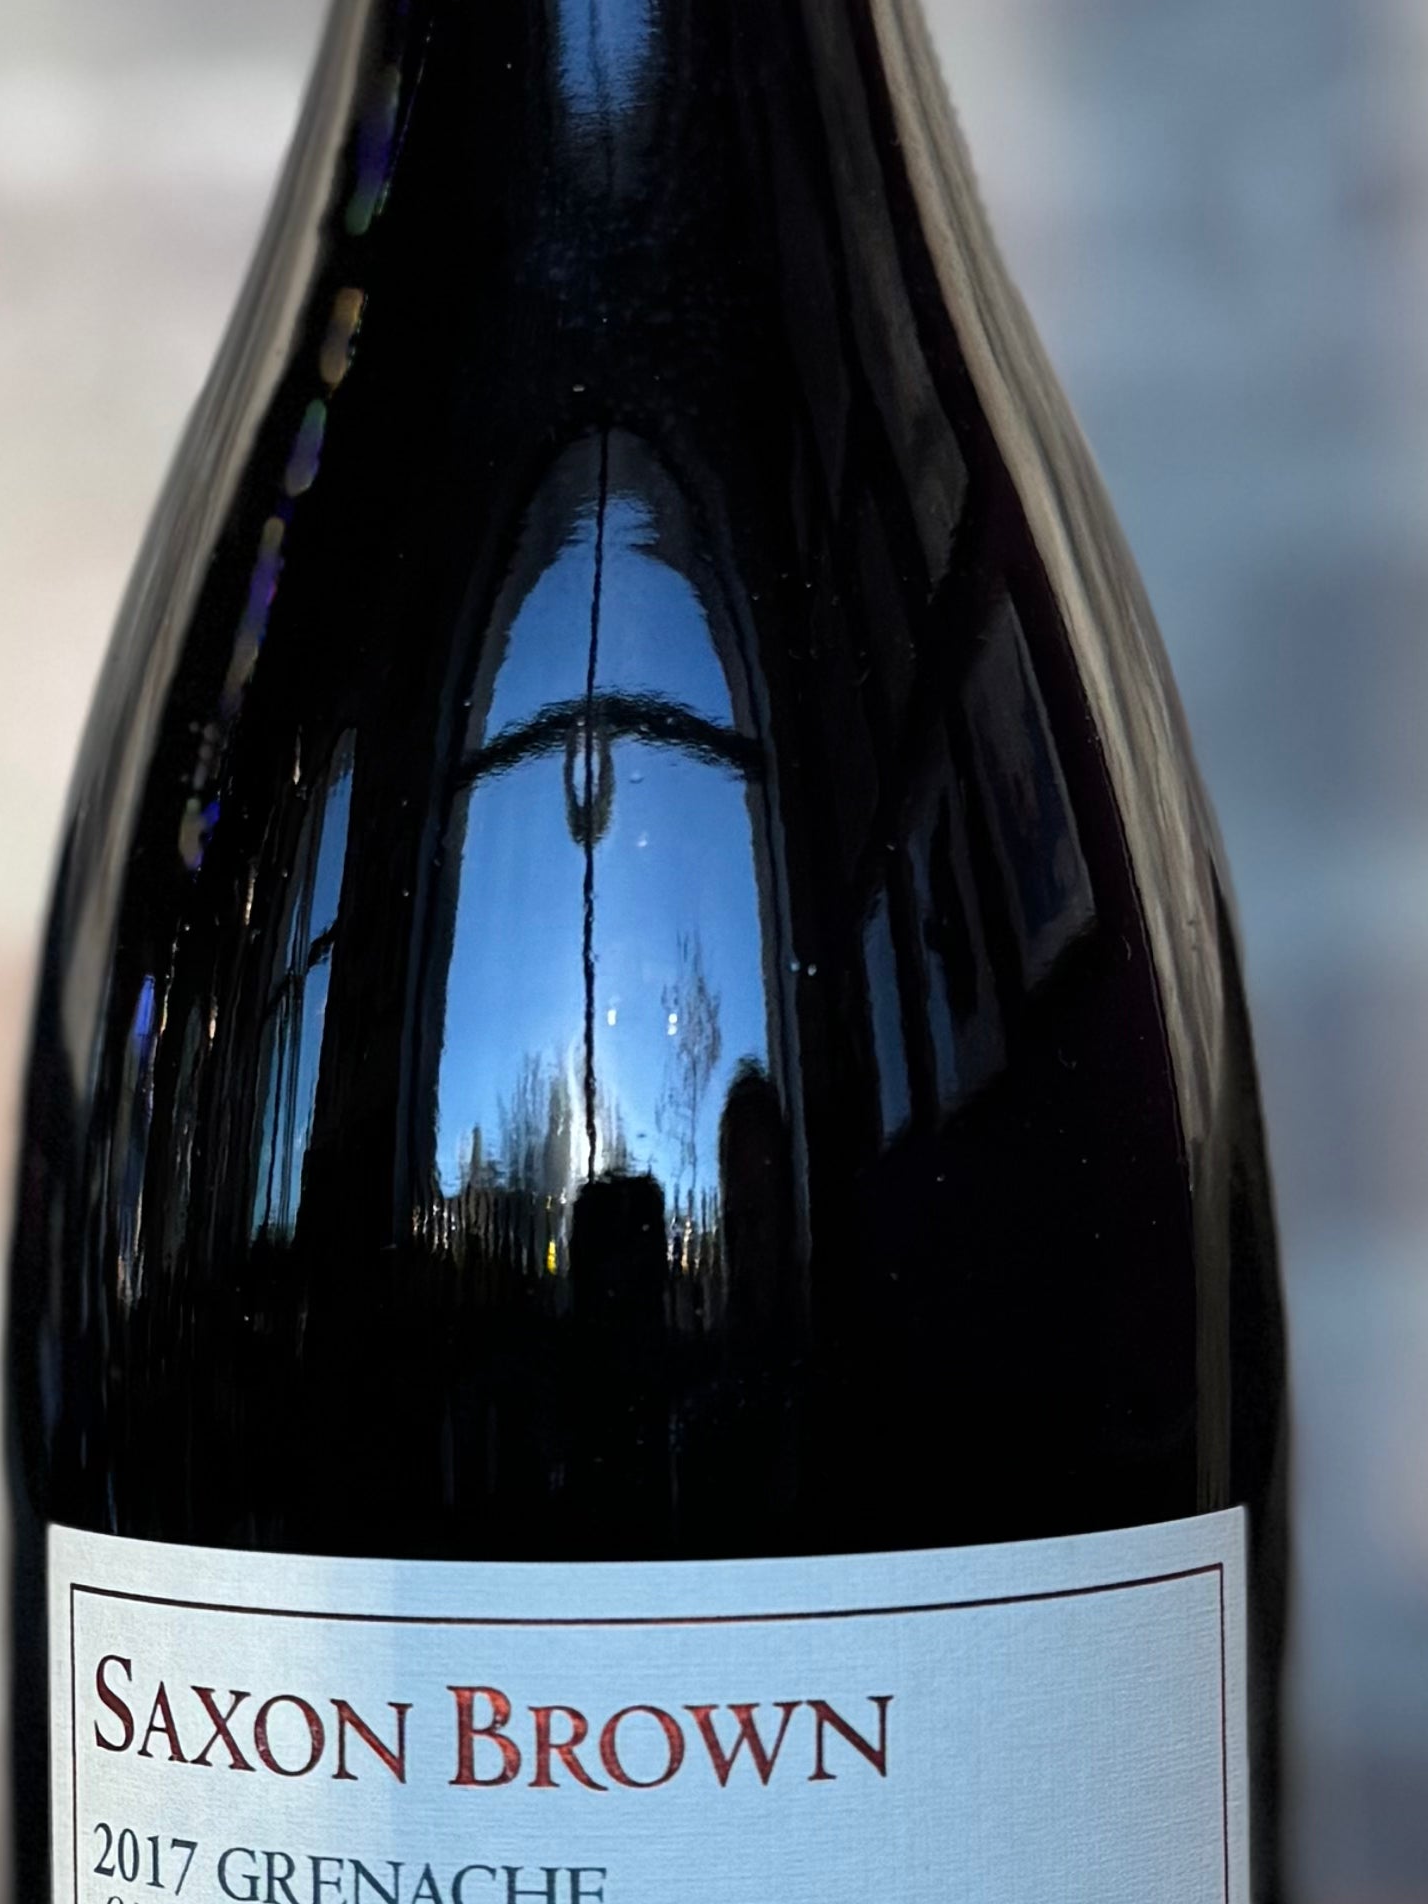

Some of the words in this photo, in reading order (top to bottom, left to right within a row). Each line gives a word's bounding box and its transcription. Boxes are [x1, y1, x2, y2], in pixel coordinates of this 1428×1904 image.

[92, 1653, 416, 1786] SAXON
[444, 1683, 896, 1793] BROWN
[92, 1821, 200, 1898] 2017
